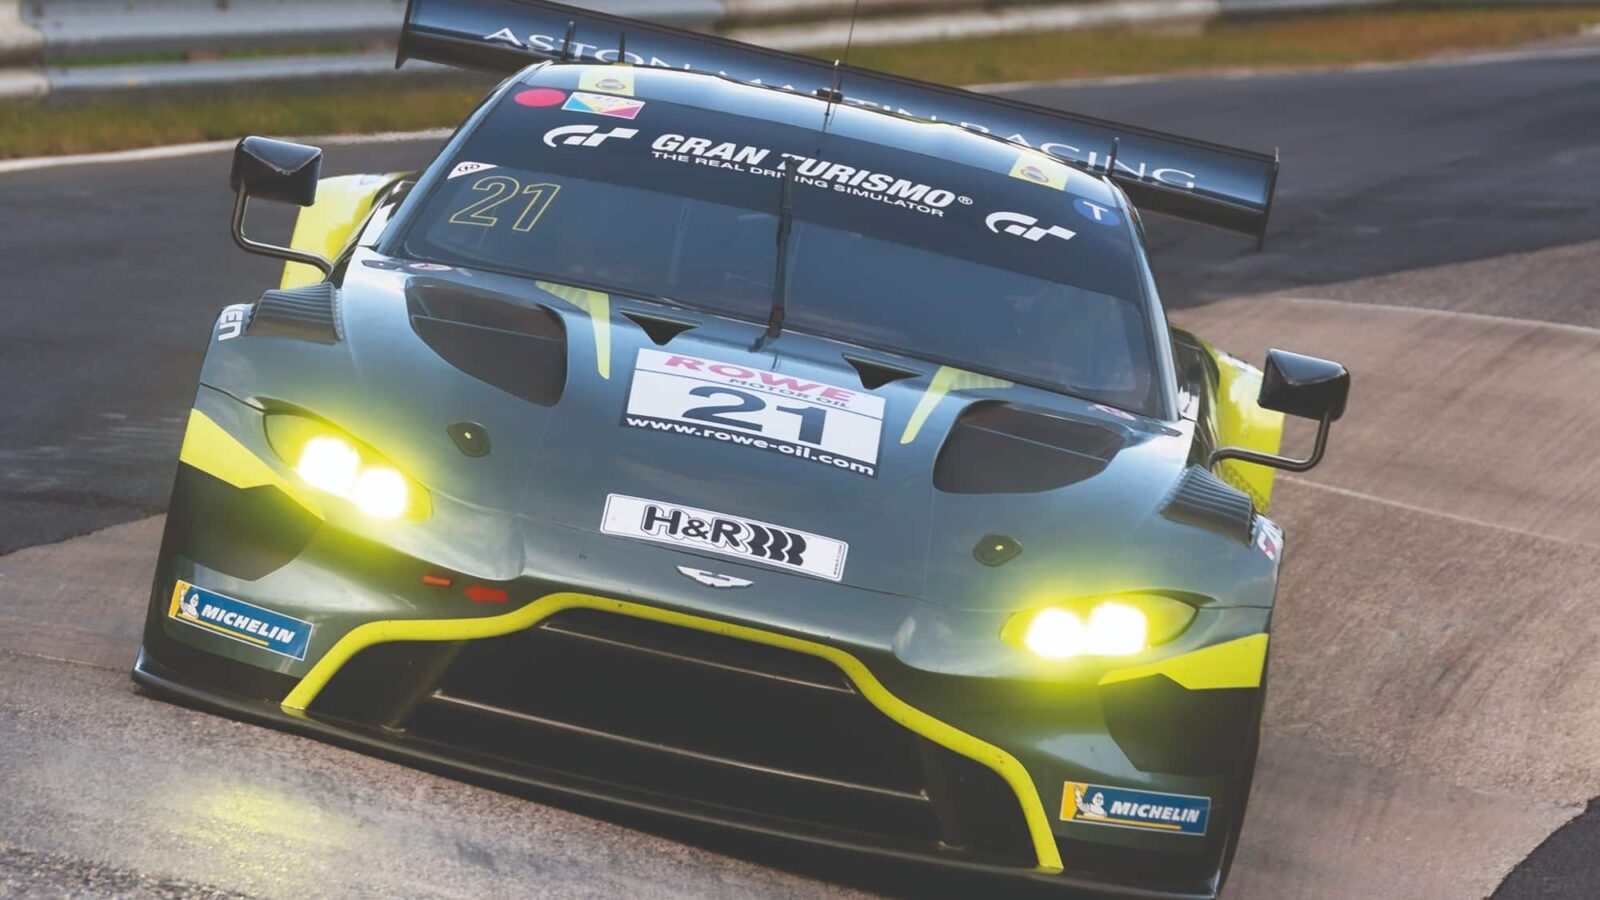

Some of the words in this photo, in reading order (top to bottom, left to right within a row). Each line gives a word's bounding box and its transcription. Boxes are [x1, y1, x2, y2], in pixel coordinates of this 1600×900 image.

[652, 134, 770, 165] GRAN
[449, 176, 561, 232] 21
[651, 151, 689, 163] THE
[695, 158, 745, 172] REAL
[750, 167, 828, 189] DRIING
[833, 183, 945, 218] SIMULATOR
[1082, 200, 1108, 221] T
[665, 356, 856, 403] ROWE
[729, 378, 811, 399] MOTOR
[816, 396, 850, 409] OIL
[682, 386, 827, 446] 21
[626, 417, 875, 476] www.rowe-oil.com
[642, 504, 750, 553] H&R
[201, 604, 296, 644] MICHELIN
[1110, 800, 1201, 824] MICHELIN
